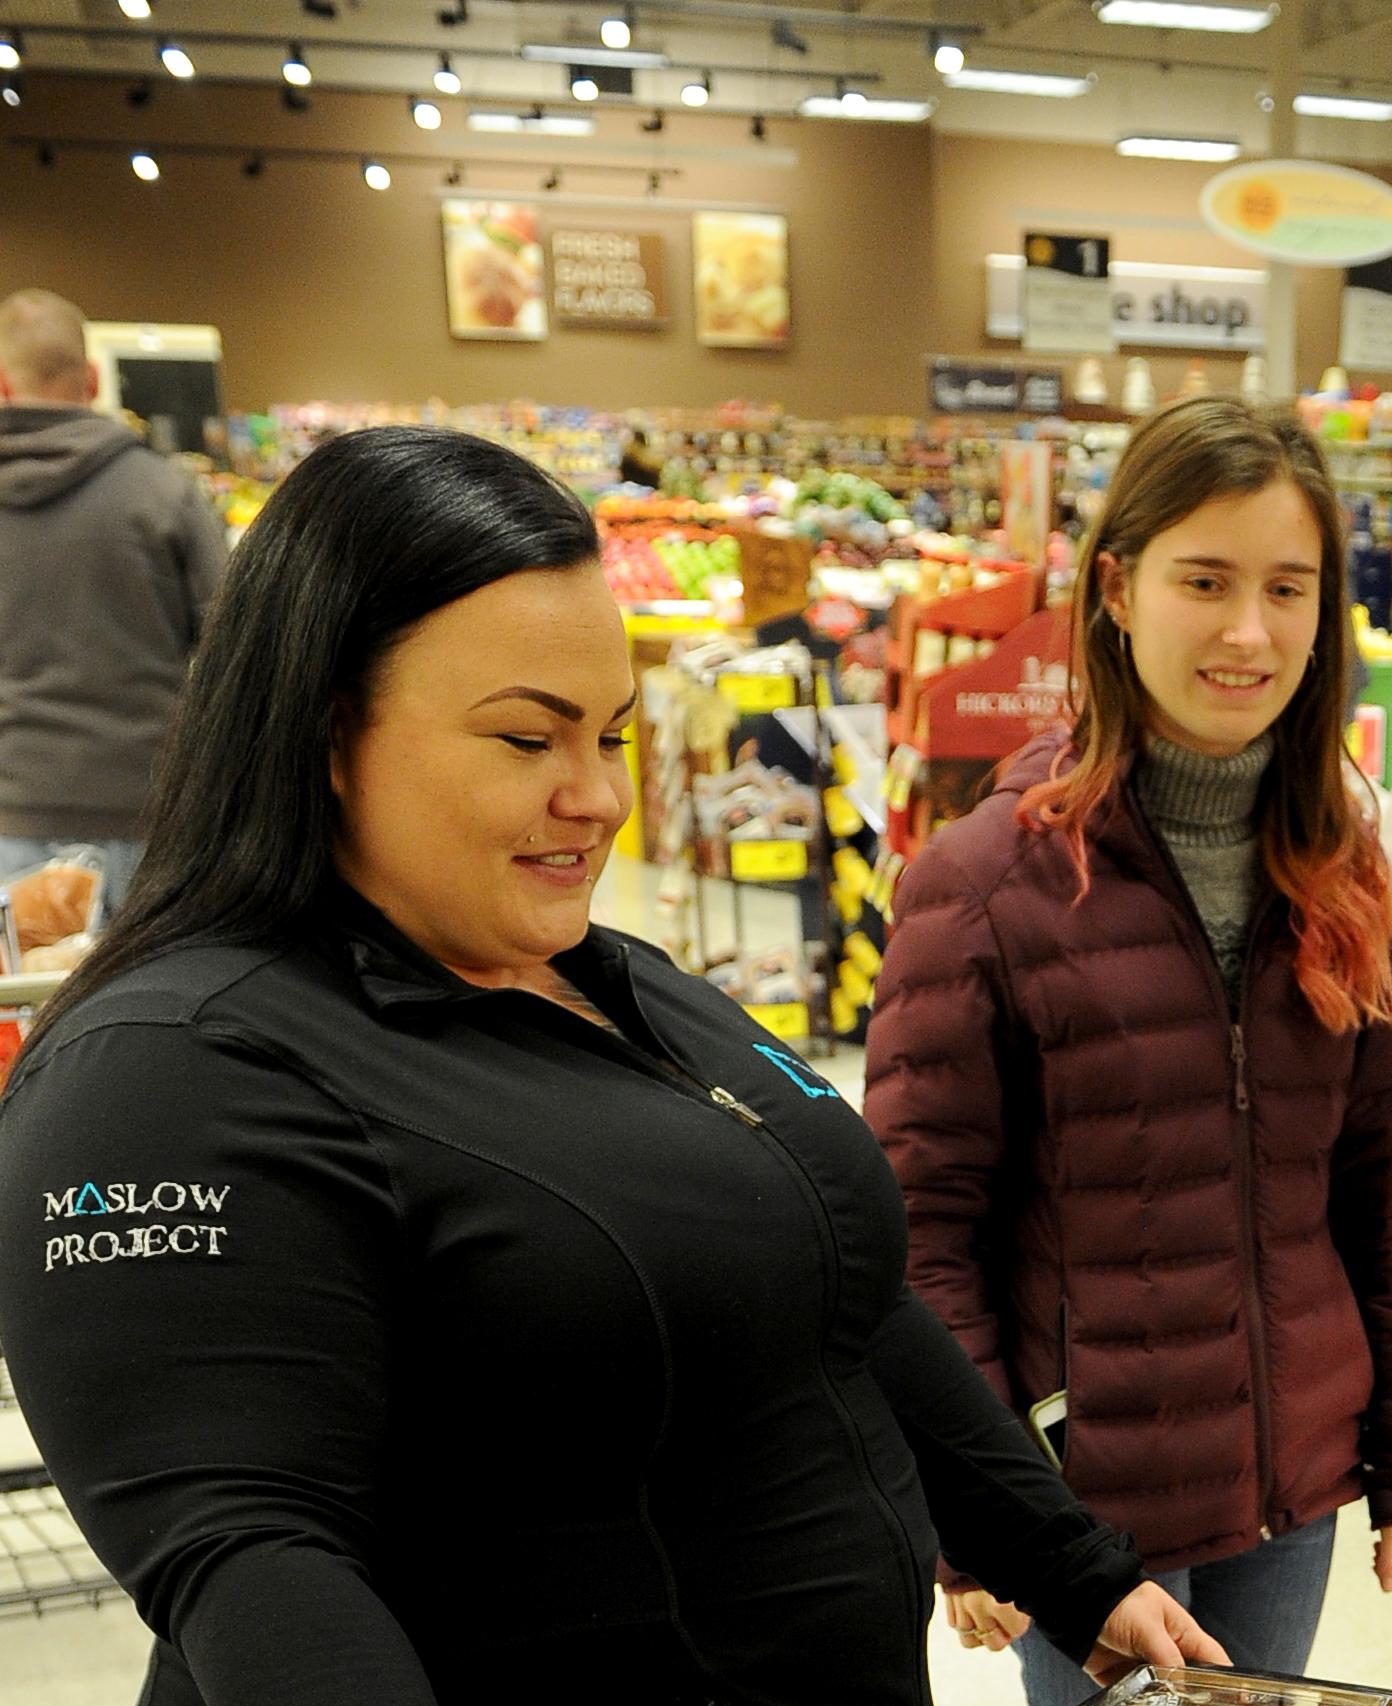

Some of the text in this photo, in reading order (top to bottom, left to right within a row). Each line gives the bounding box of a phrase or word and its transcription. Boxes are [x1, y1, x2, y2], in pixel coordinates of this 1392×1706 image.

[1079, 239, 1099, 277] 1
[1152, 284, 1249, 337] shop
[43, 1181, 231, 1222] MASLOW
[45, 1224, 228, 1272] PROJECT
